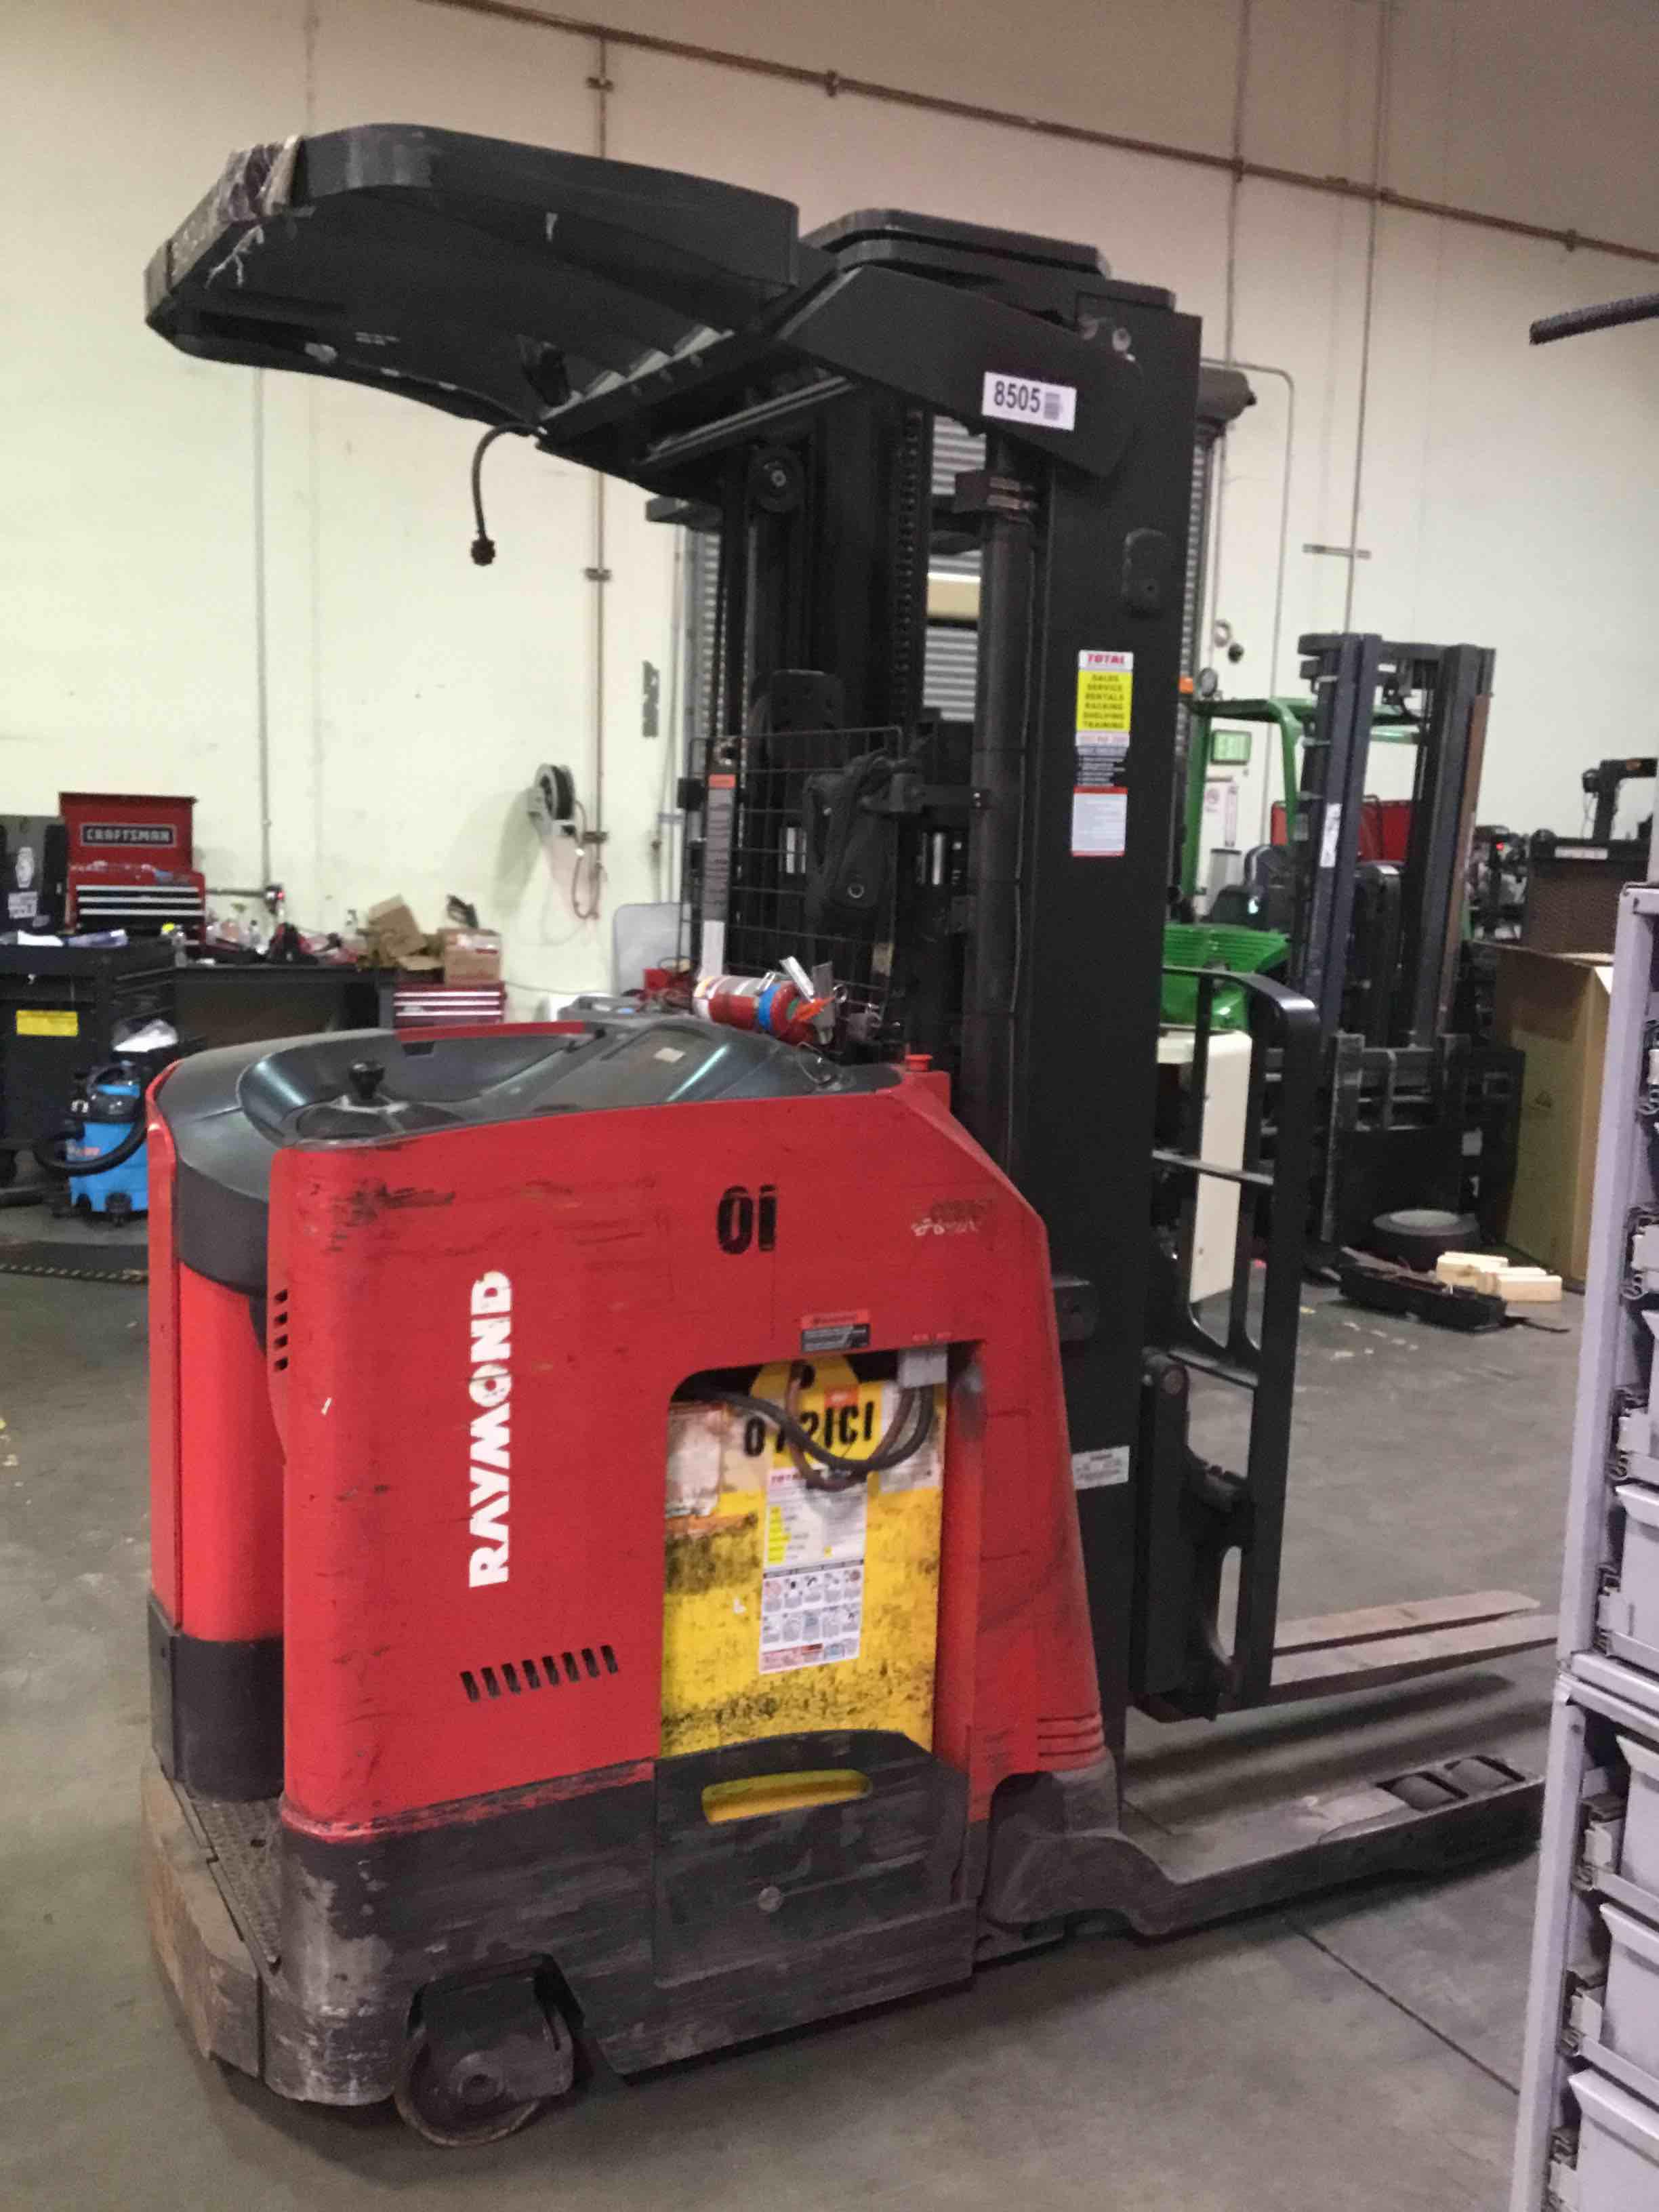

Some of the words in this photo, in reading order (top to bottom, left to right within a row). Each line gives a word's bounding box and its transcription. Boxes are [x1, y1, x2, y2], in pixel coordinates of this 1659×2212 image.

[994, 380, 1042, 413] 8505
[86, 828, 170, 842] CRAFTSMAN
[468, 1271, 512, 1589] RAYMOND
